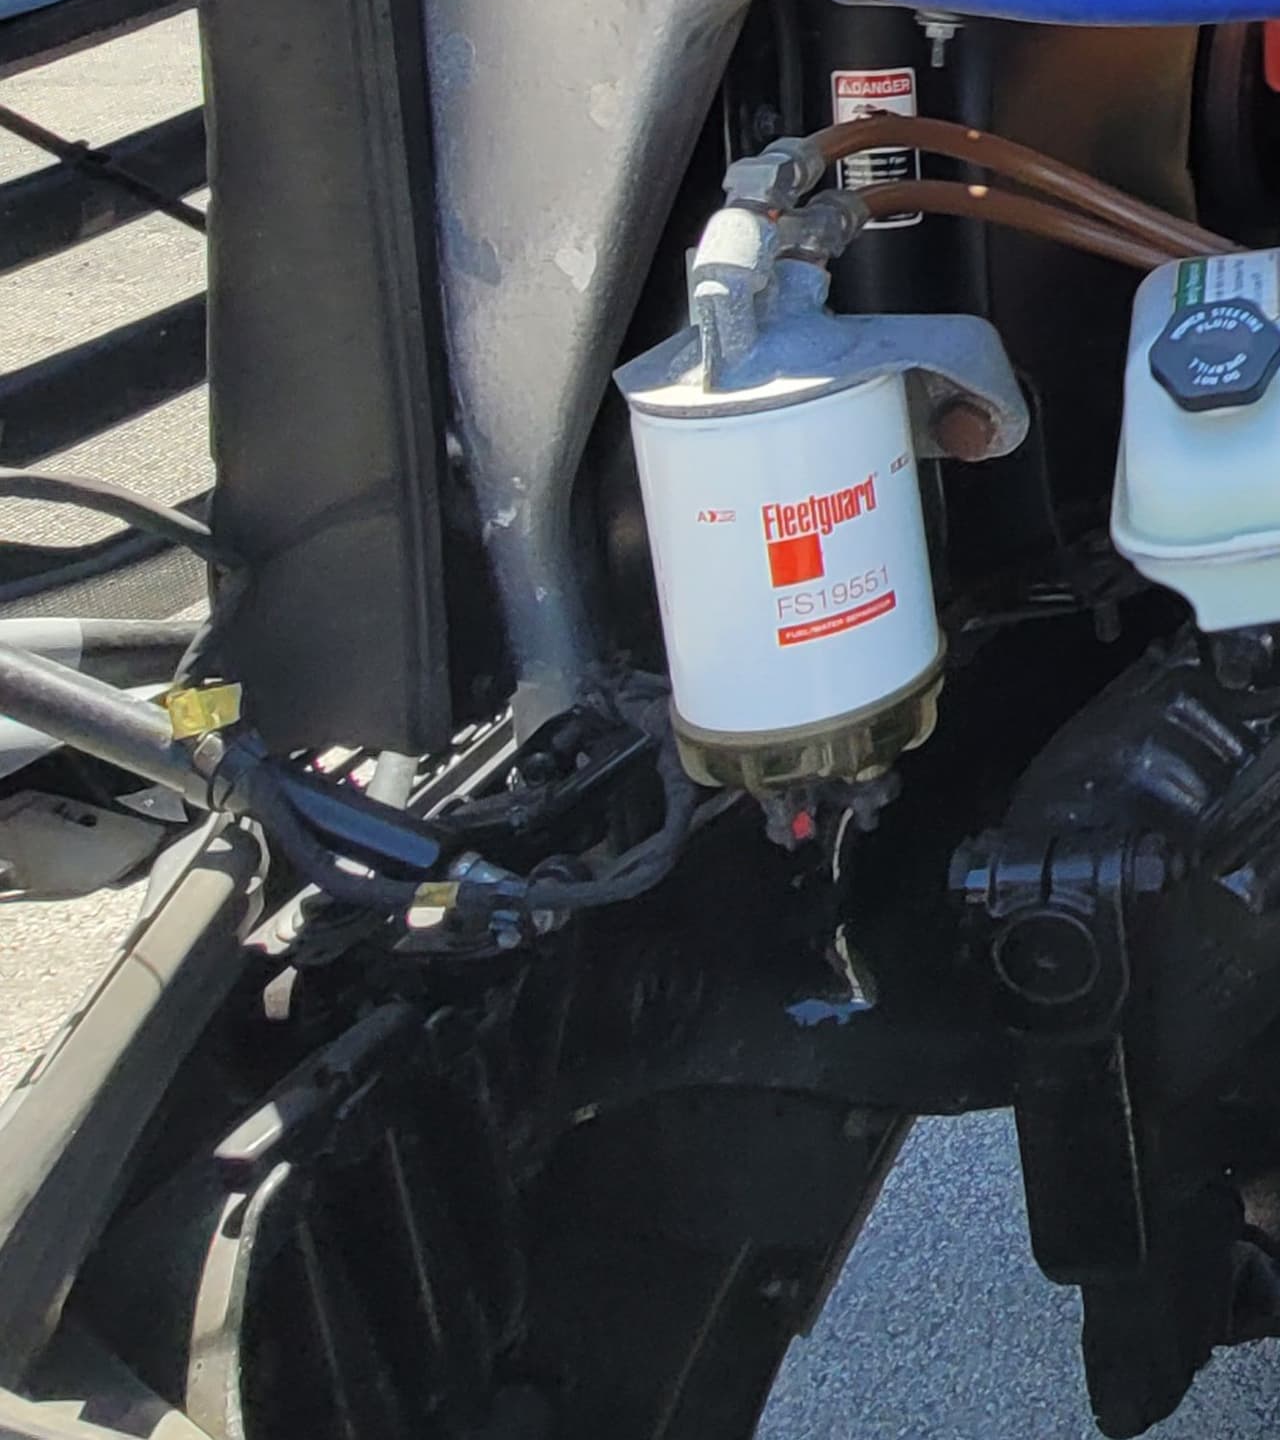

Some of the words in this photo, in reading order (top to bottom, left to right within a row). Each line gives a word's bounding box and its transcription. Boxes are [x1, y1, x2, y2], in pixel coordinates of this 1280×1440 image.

[850, 77, 911, 95] DANGER
[1195, 318, 1239, 334] FLUID
[1210, 306, 1265, 334] STEERING
[761, 474, 878, 540] Fleetguard
[777, 564, 890, 619] FS19551
